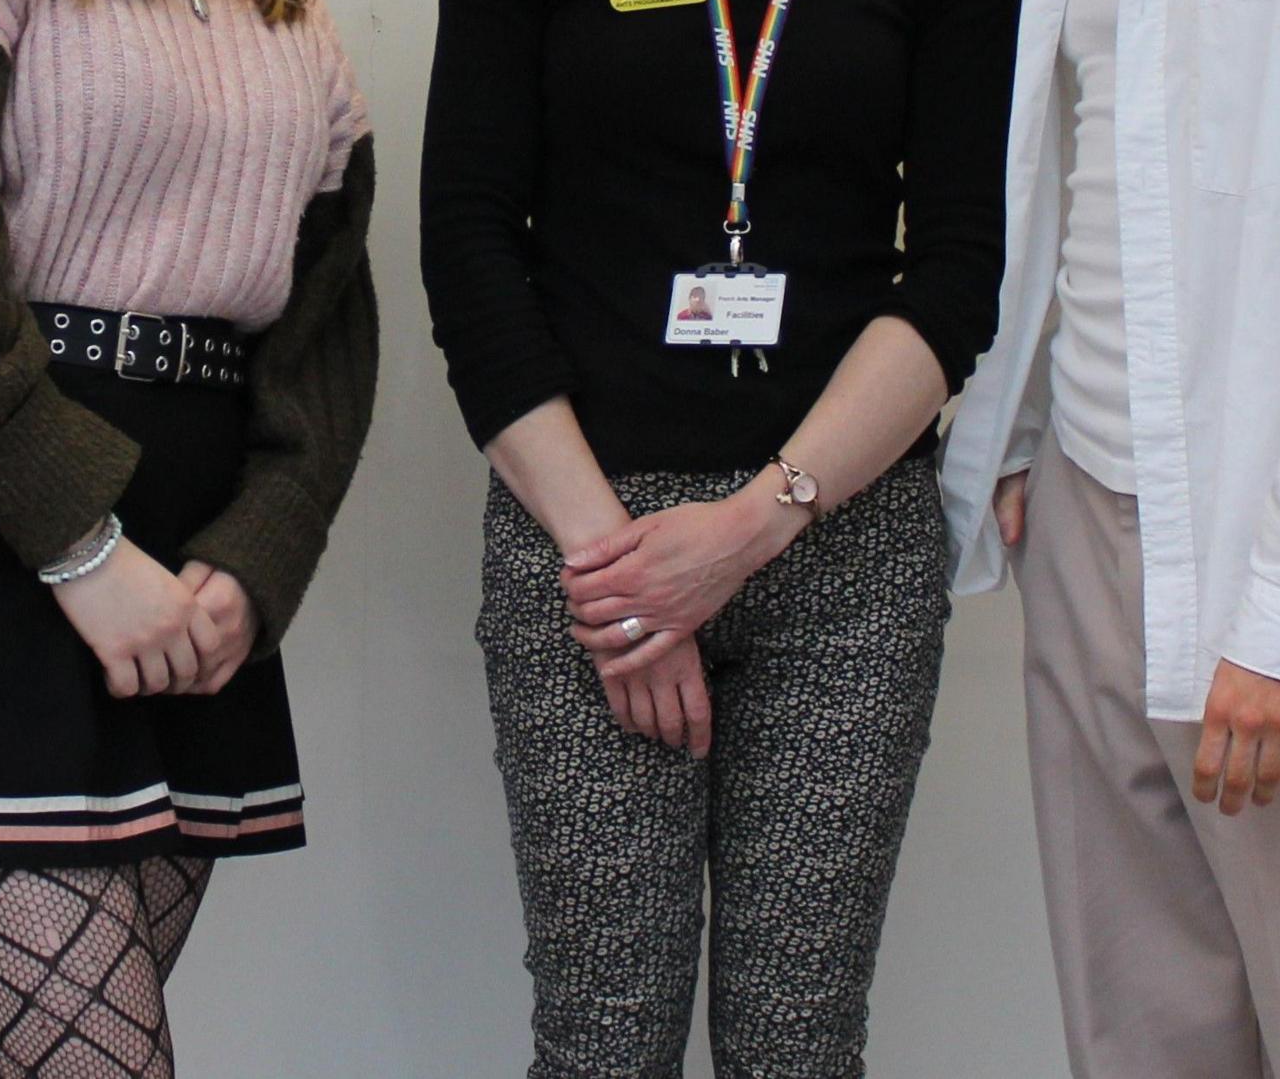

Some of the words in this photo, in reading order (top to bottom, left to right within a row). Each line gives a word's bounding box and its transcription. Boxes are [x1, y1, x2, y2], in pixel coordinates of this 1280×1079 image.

[714, 27, 734, 67] NHS
[752, 38, 775, 78] NHS
[723, 100, 740, 140] NHS
[737, 109, 756, 150] NHS
[674, 328, 701, 336] Donna
[704, 327, 729, 336] Baber
[726, 311, 764, 319] Facilities
